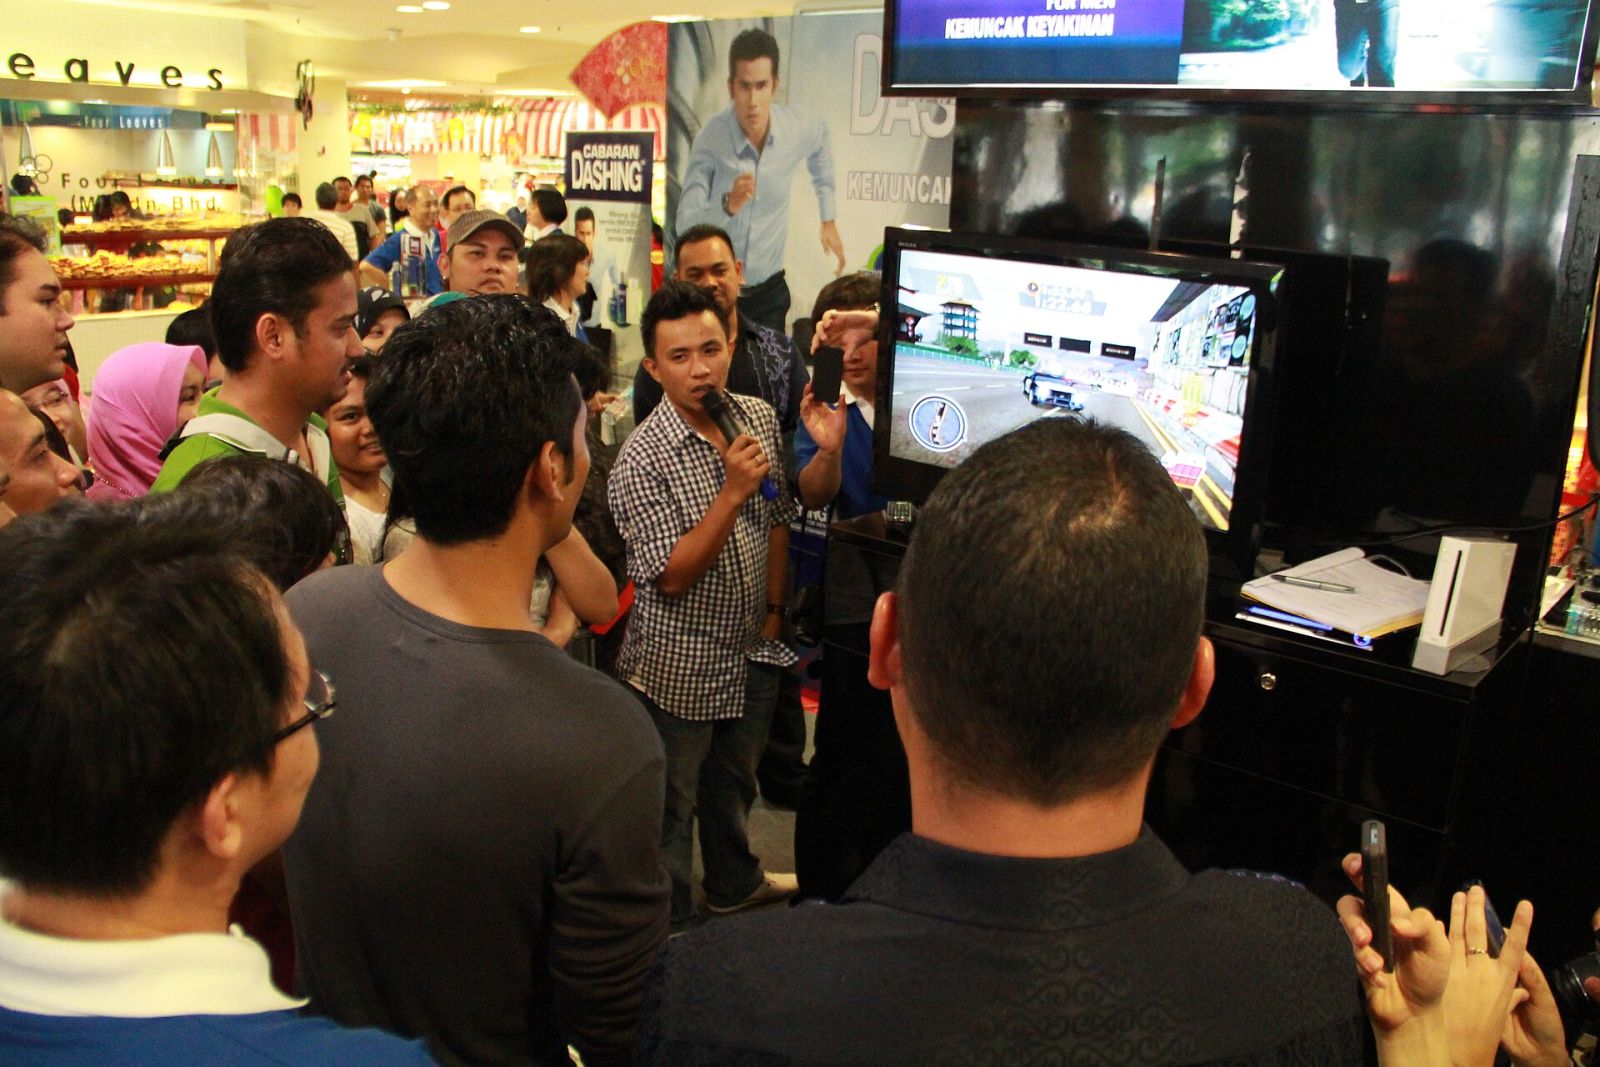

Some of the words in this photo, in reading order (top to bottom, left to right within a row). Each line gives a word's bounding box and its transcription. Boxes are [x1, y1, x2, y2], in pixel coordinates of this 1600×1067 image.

[944, 15, 1026, 39] KEMUNCAK
[1026, 13, 1115, 38] KEYAKINAN
[583, 143, 639, 160] CABARAN
[61, 173, 118, 189] Four
[571, 149, 643, 192] DASHING
